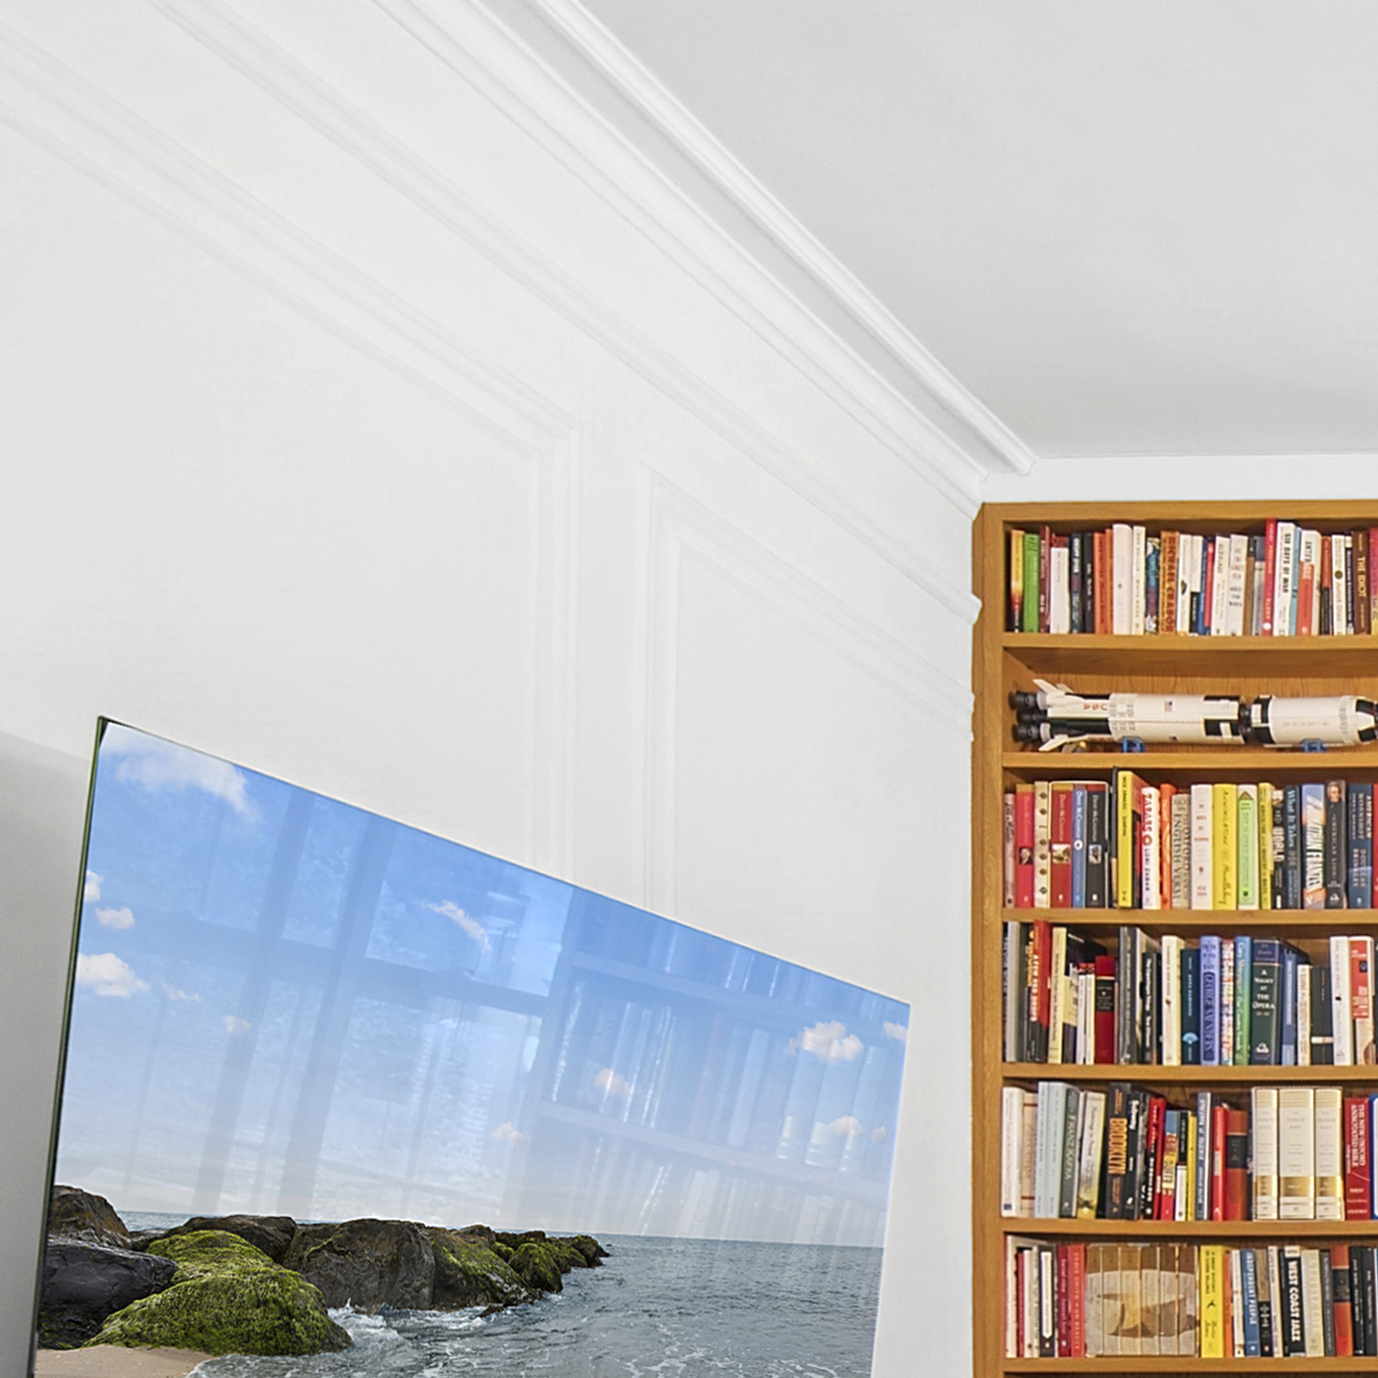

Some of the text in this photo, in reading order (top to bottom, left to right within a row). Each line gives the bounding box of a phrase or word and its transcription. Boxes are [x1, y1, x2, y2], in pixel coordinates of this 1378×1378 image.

[1358, 575, 1366, 597] IDIOT
[1287, 790, 1296, 847] What It Takes
[1173, 814, 1182, 900] ENGLISH VERSE
[1204, 974, 1214, 1052] GEORGE SAUNDERS
[1065, 1115, 1076, 1180] FRANZ KAFKA
[1108, 1118, 1128, 1174] BROOKLYN
[1246, 1252, 1255, 1298] INDEPENDENT
[1288, 1261, 1300, 1342] WEST COAST JAZZ
